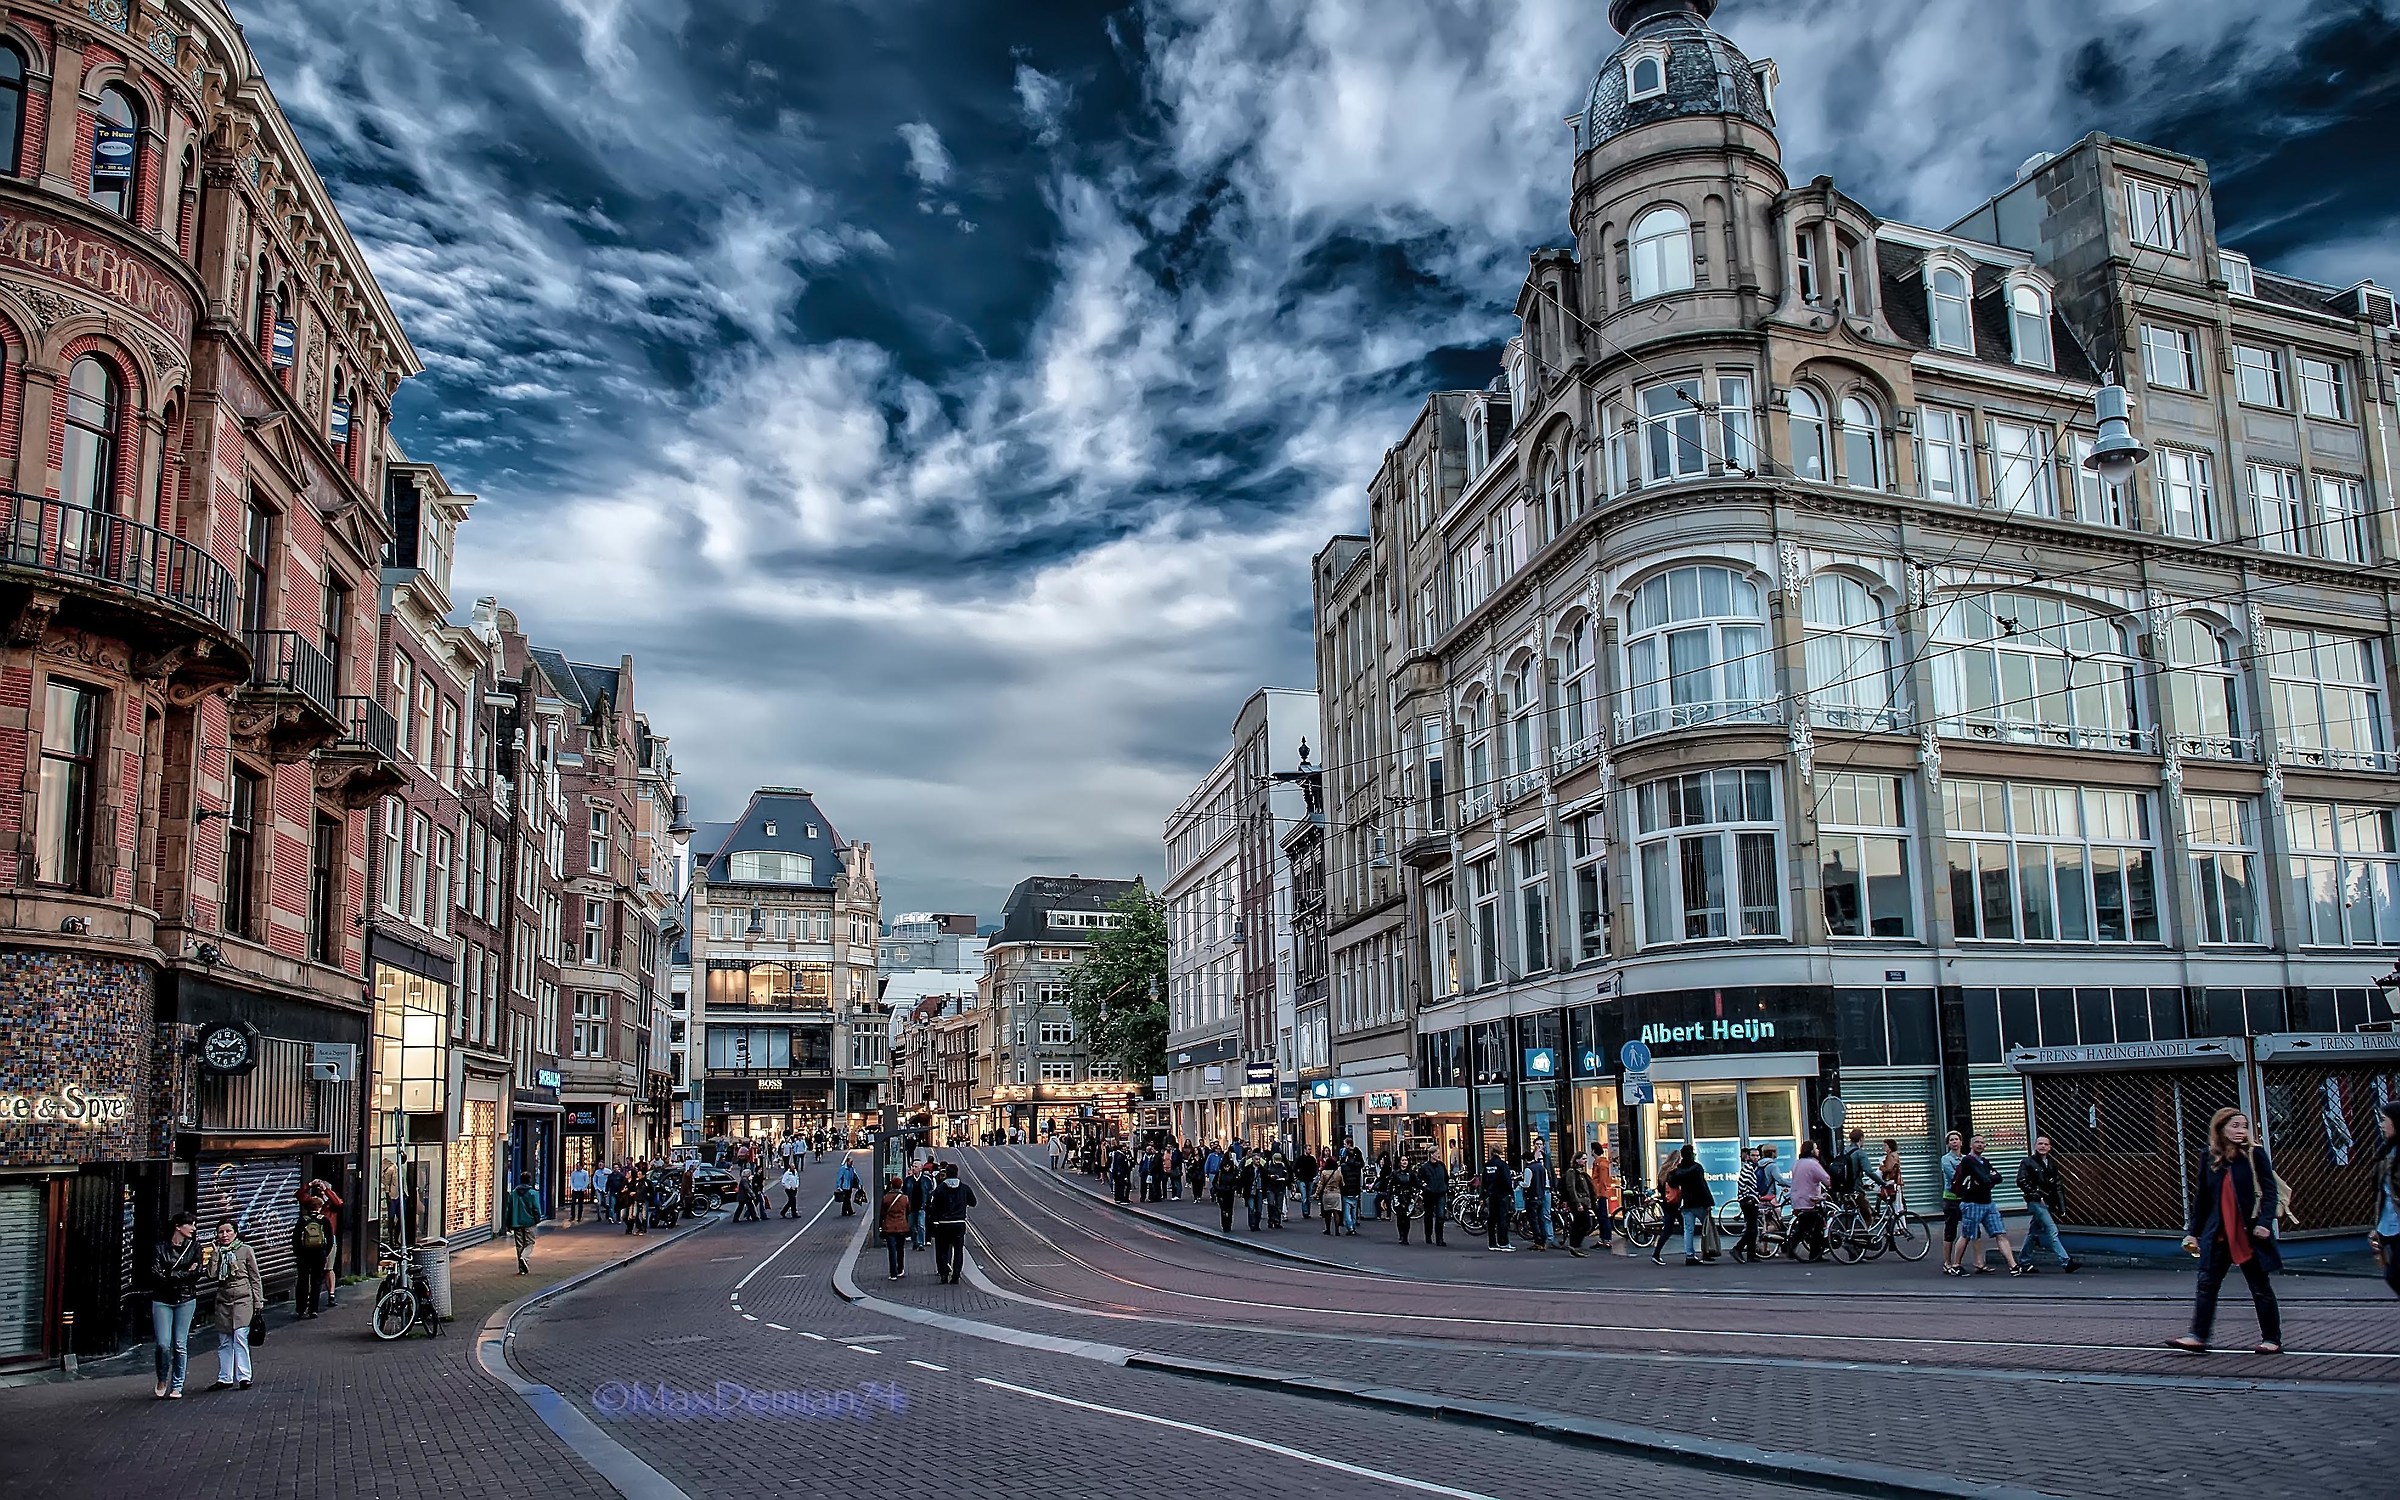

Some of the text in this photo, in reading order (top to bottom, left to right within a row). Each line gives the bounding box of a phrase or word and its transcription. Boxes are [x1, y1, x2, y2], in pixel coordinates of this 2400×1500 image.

[112, 130, 134, 138] Huur
[1641, 1018, 1775, 1044] Albert Heijn
[2320, 1037, 2355, 1050] FRENS
[2039, 1043, 2194, 1062] FRENS HARINGHANDEL
[758, 1079, 783, 1088] BOSS
[38, 1098, 58, 1118] &
